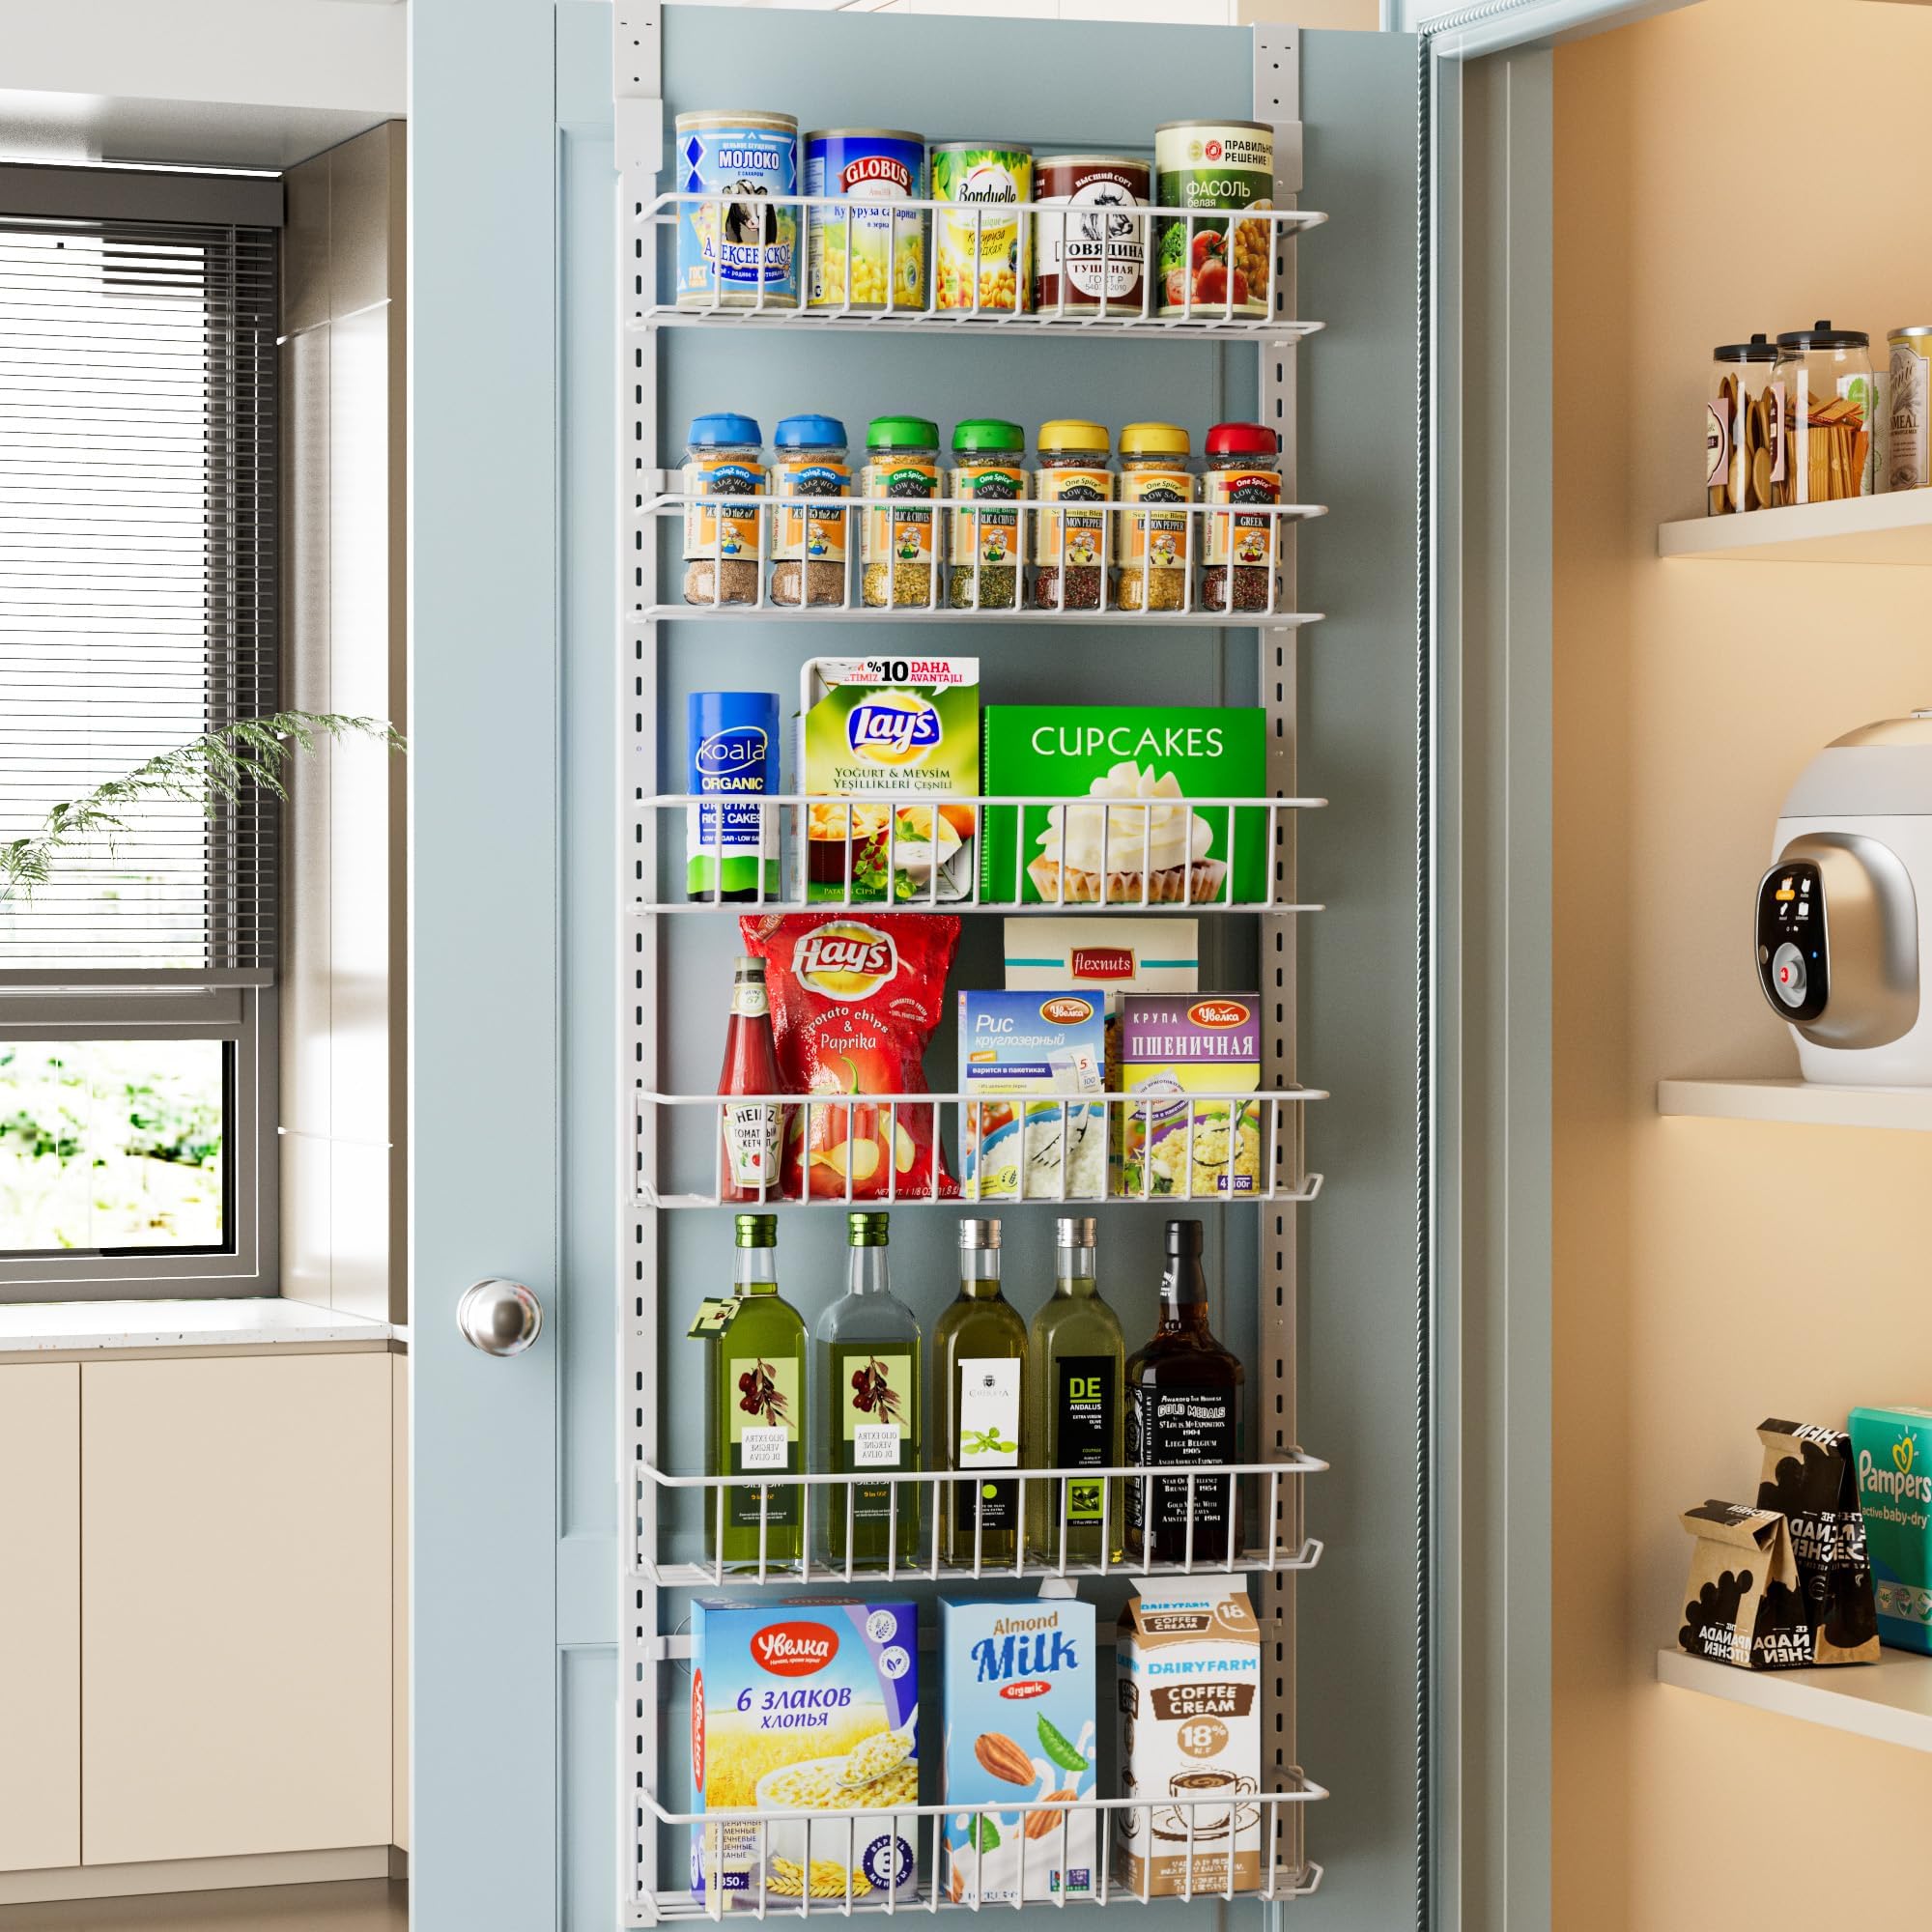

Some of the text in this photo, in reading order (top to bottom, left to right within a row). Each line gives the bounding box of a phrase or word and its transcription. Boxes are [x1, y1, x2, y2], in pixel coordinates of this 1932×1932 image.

[718, 150, 780, 170] МОЛОКО
[1225, 153, 1267, 166] РЕШЕНИЕ
[845, 158, 909, 186] GLOBUS
[1075, 172, 1133, 188] ВЫСШИЙ СОРТ
[958, 183, 1017, 203] Bonduelle
[1186, 180, 1251, 197] ФАСОЛЬ
[1187, 196, 1216, 208] белая
[834, 206, 917, 221] Кууруза саарная
[967, 230, 1006, 245] Куруза
[703, 237, 790, 266] АЕКСЕЕСКОЕ
[967, 243, 1003, 256] сдкая
[1065, 243, 1144, 259] ОВЯДИНА
[1073, 264, 1133, 275] ТУШНАЯ
[894, 470, 924, 481] One Spice
[980, 473, 1009, 484] One Spice
[1081, 477, 1097, 487] Spice
[1236, 477, 1268, 489] One Spice
[891, 482, 927, 496] LOW SALT
[977, 485, 995, 496] LOW
[1162, 480, 1178, 490] Spice
[1063, 488, 1101, 501] LOW SALT
[1143, 491, 1162, 502] LOW
[1234, 488, 1271, 501] LOW SALT
[912, 512, 929, 523] CHIVES
[1240, 516, 1264, 526] GREEK
[1163, 520, 1184, 531] PEPPER
[867, 661, 951, 682] %10 DAHA
[910, 673, 963, 684] AVANTAJLI
[854, 708, 934, 754] Lay's
[1032, 726, 1224, 757] CUPCAKES
[700, 740, 766, 761] koala
[835, 767, 884, 778] YOĞURT
[889, 768, 899, 778] &
[701, 777, 764, 790] ORGANIC
[824, 887, 854, 895] PATATS
[790, 938, 888, 973] Hay's
[1074, 952, 1131, 972] flexnuts
[915, 1002, 927, 1016] FRESH
[1049, 1005, 1084, 1018] Увелка
[1198, 1007, 1239, 1023] Увелка
[854, 1009, 889, 1034] chips
[975, 1014, 1013, 1034] Рис
[1133, 1012, 1179, 1024] КРУПА
[843, 1020, 853, 1033] &
[821, 1033, 877, 1054] Paprika
[975, 1033, 1065, 1049] круглозерный
[1131, 1036, 1254, 1057] ПШЕНИЧНАЯ
[972, 1066, 1002, 1075] варится
[1080, 1058, 1088, 1070] 5
[736, 1108, 775, 1123] HEIZ
[734, 1125, 777, 1138] ТОМАТЫЙ
[743, 1139, 771, 1148] КЕТЧП
[1069, 1377, 1101, 1398] DE
[1158, 1404, 1226, 1419] GOLD MEDALS
[1859, 1449, 1932, 1504] Pampers
[1862, 1505, 1927, 1530] active baby-dry
[1142, 1601, 1210, 1611] DAIRYFARM
[993, 1610, 1059, 1636] Almond
[1154, 1616, 1198, 1626] COFFEE
[757, 1633, 830, 1660] Увелка
[971, 1631, 1079, 1683] Milk
[1148, 1659, 1256, 1675] DAIRYFARM
[1007, 1682, 1043, 1697] Organic
[1168, 1686, 1237, 1701] COFFEE
[737, 1687, 852, 1712] 6 злаков
[1170, 1699, 1236, 1715] CREAM
[760, 1712, 829, 1729] хлопья
[870, 1838, 905, 1853] ВАРТЬ
[869, 1870, 908, 1888] МИНТЫ
